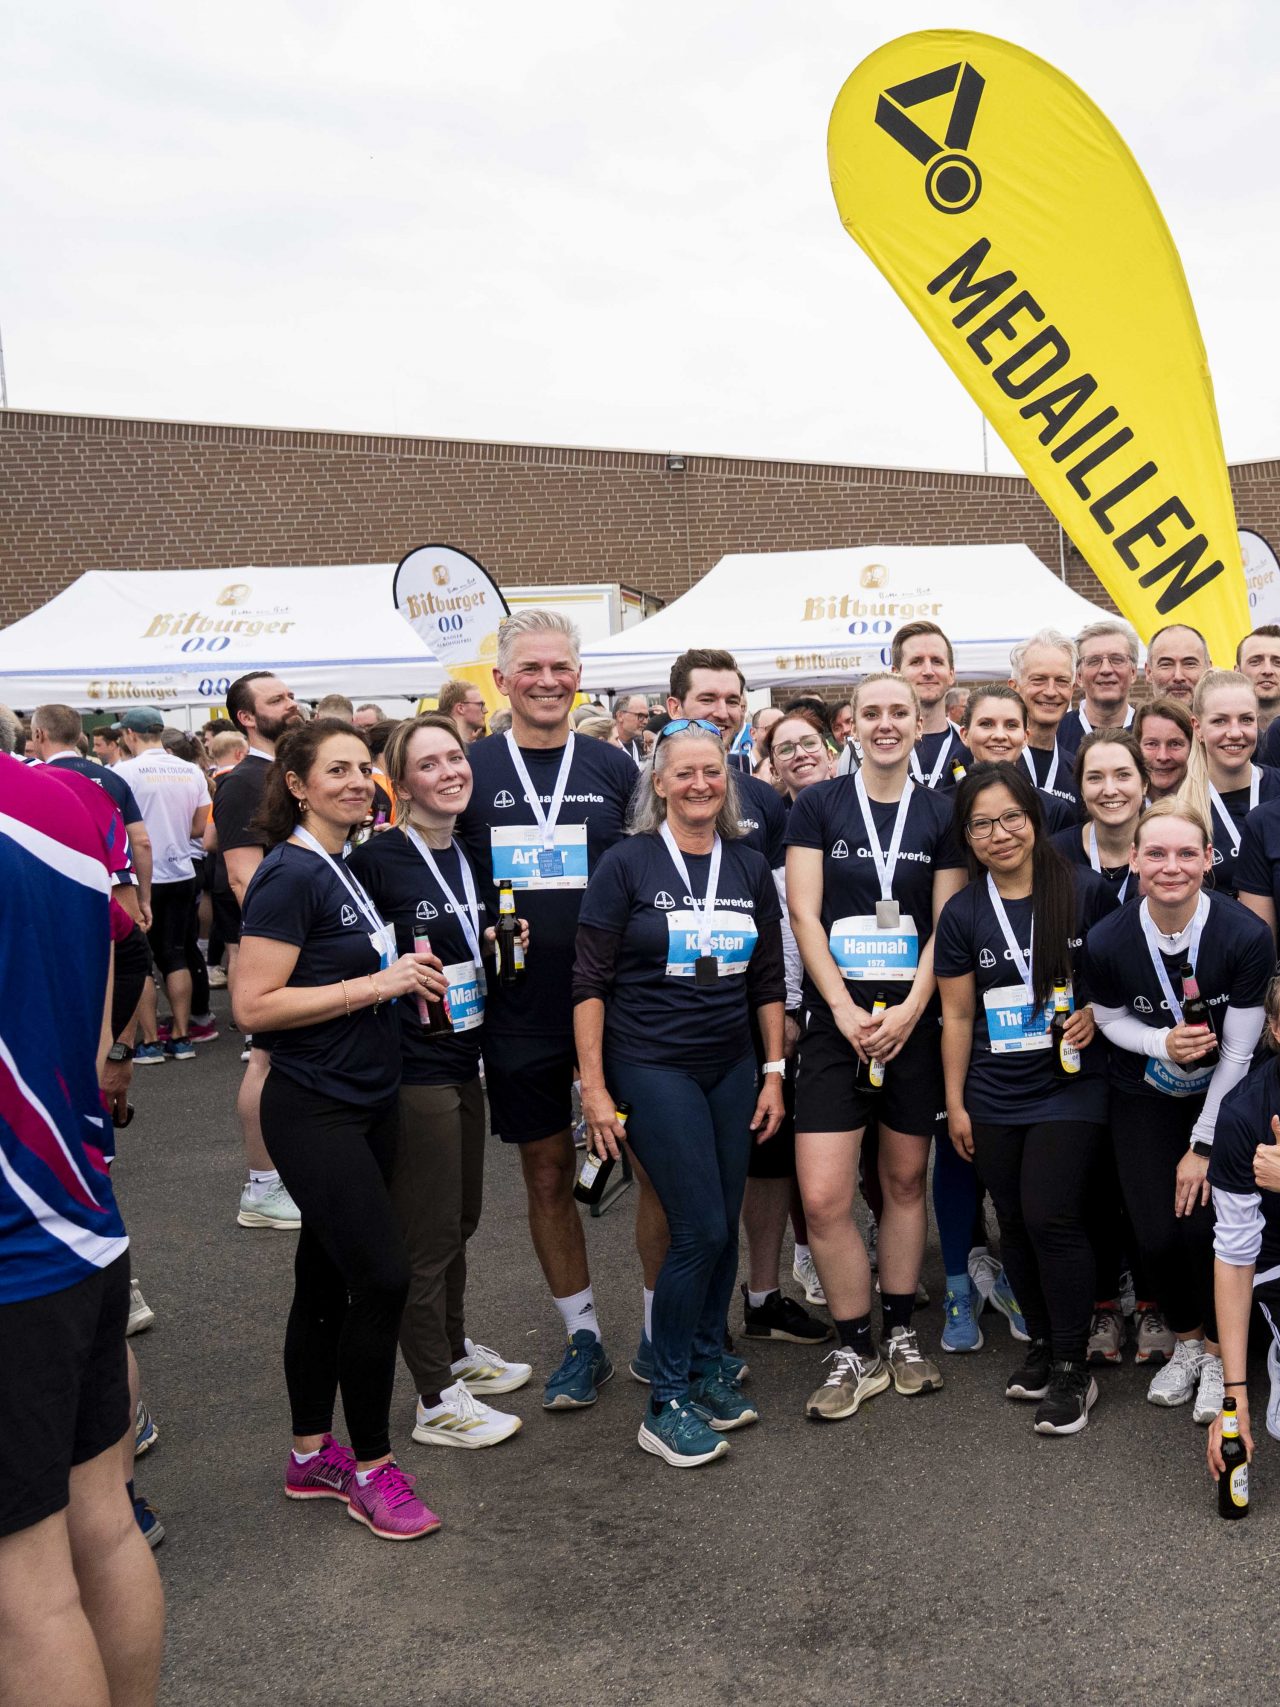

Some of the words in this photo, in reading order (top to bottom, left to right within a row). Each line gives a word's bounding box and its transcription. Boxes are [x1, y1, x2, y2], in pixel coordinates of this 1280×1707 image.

[927, 237, 1224, 615] MEDAILLEN
[406, 592, 485, 619] Bitburger
[800, 594, 943, 622] Bitburger
[139, 611, 296, 638] Bitburger
[438, 614, 463, 633] 0.0
[848, 620, 892, 635] 0.0
[181, 636, 231, 652] 0.0
[795, 653, 862, 670] Bitburger
[107, 681, 178, 700] Bitburger
[198, 678, 230, 696] 0.0
[512, 848, 568, 865] Artr
[683, 895, 754, 908] Quazwerke
[685, 933, 744, 950] Kisten
[844, 938, 908, 955] Hannah
[867, 959, 886, 967] 1572
